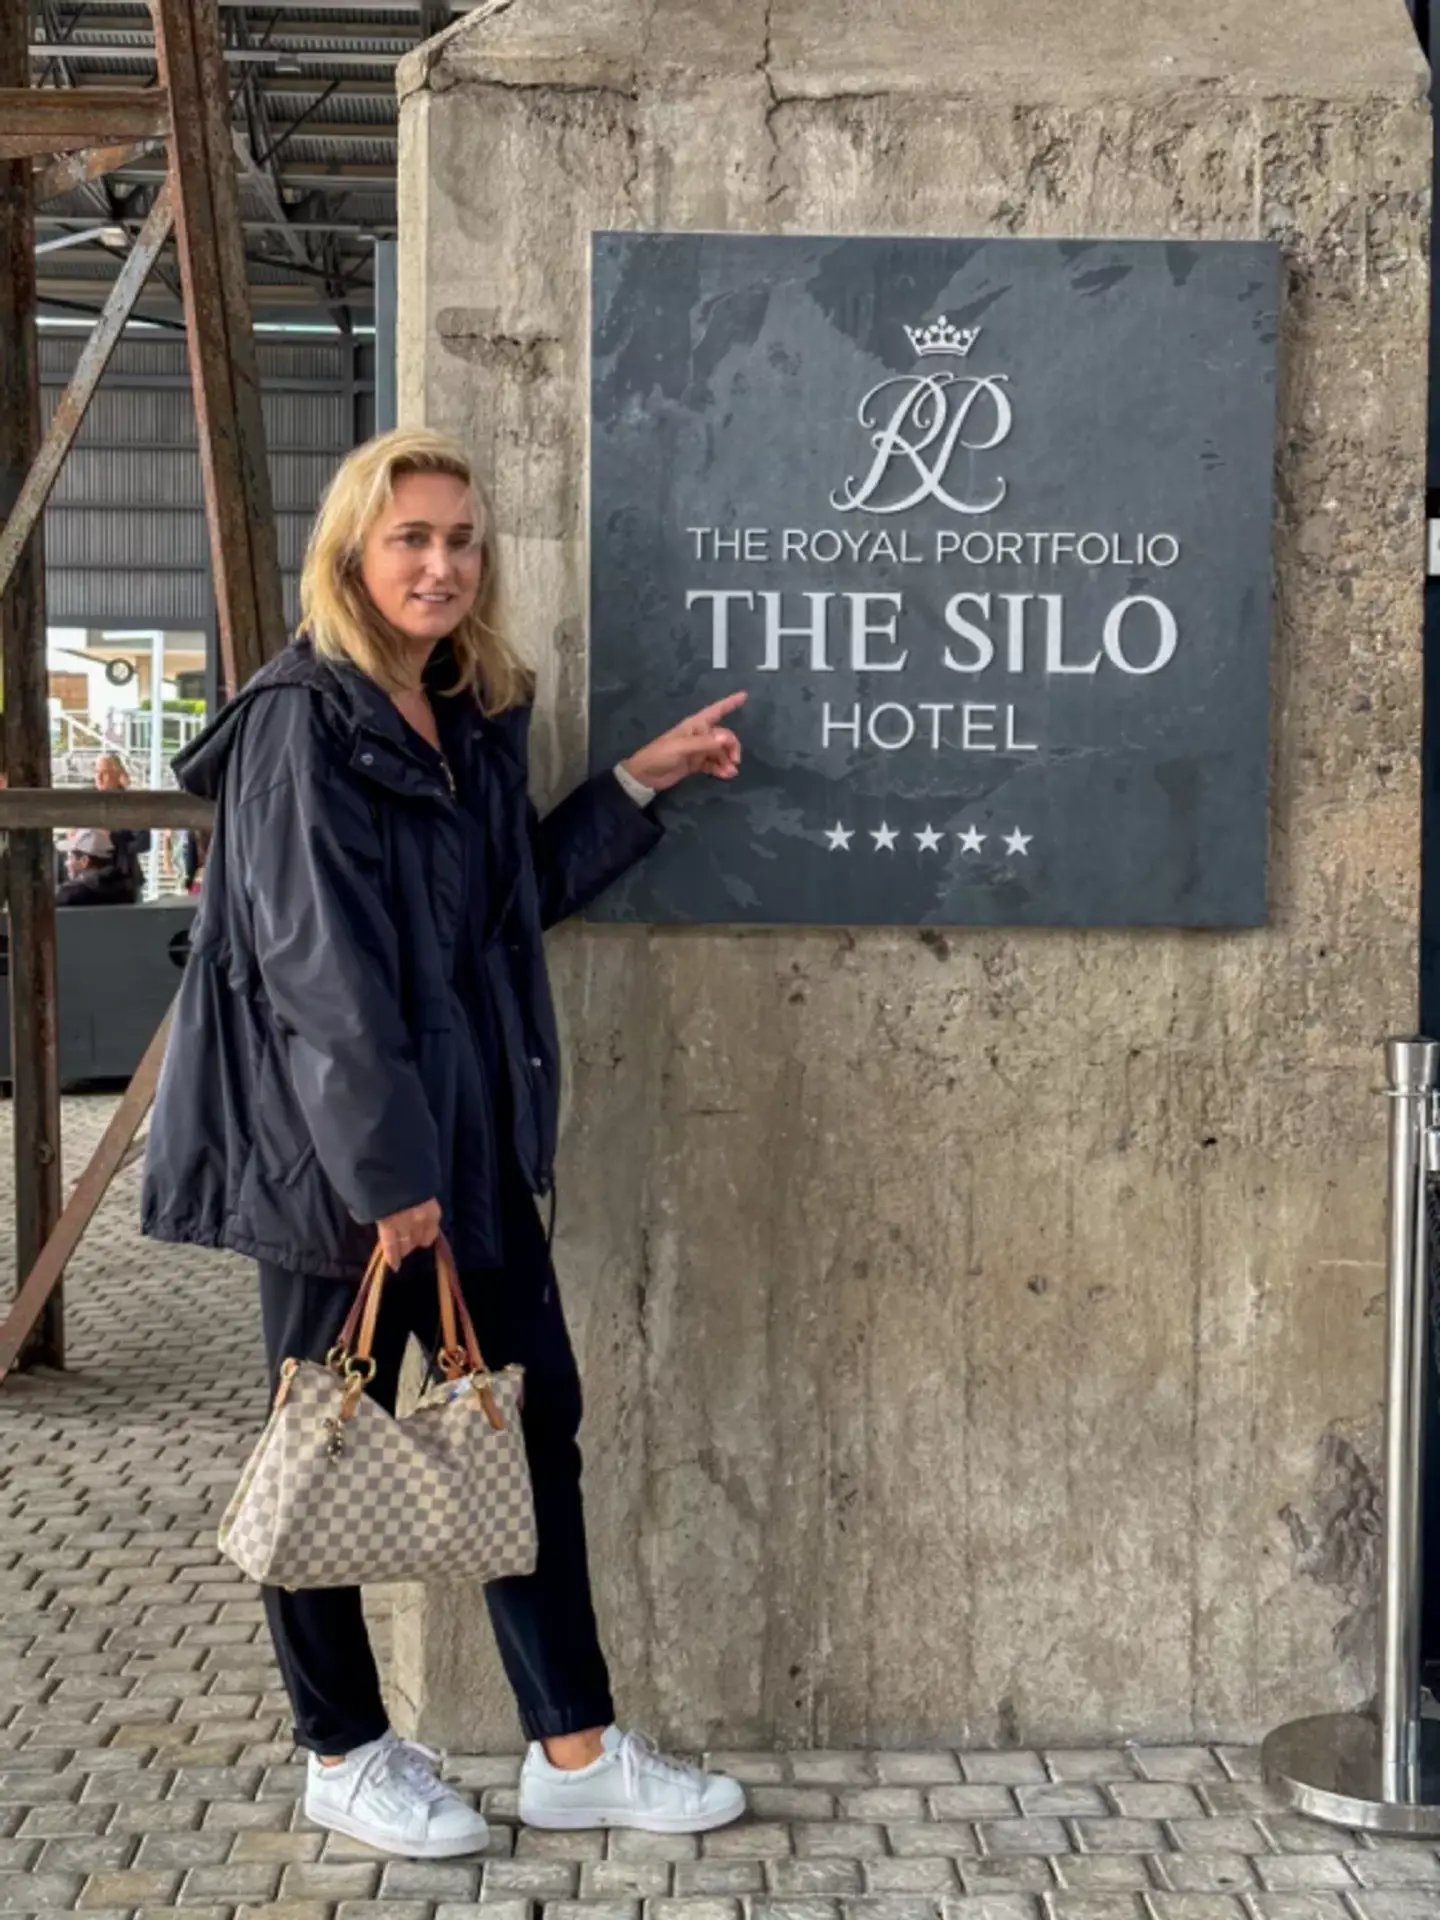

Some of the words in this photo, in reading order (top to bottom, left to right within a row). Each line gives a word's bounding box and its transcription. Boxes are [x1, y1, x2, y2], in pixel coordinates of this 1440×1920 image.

[686, 527, 768, 562] THE
[782, 529, 923, 564] ROYAL
[936, 531, 1180, 567] PORTFOLIO
[685, 589, 908, 672] THE
[943, 591, 1179, 675] SILO
[821, 701, 1038, 752] HOTEL
